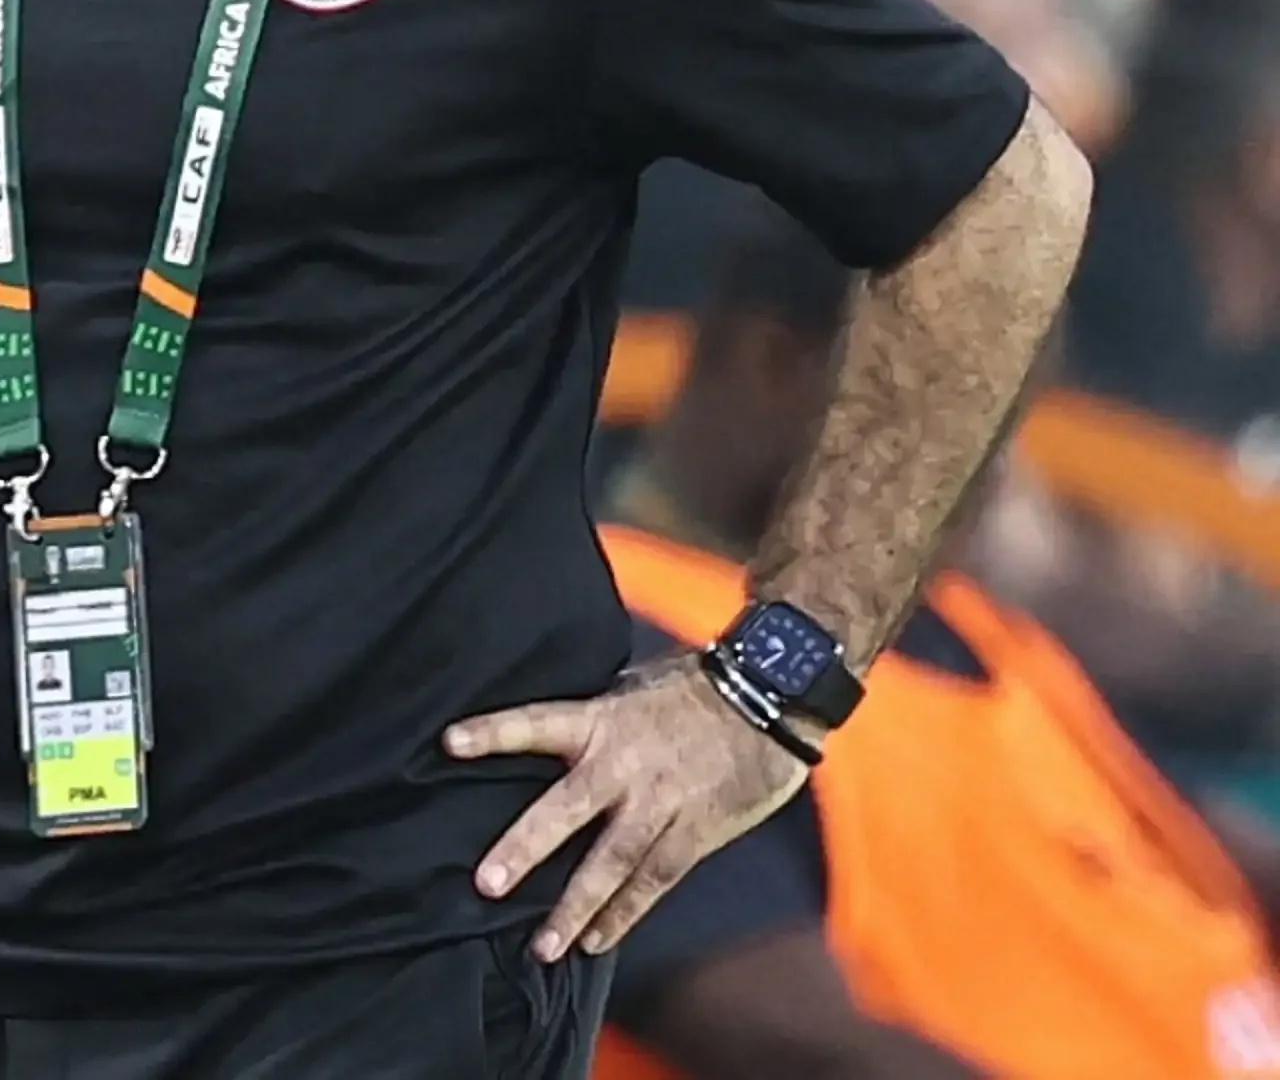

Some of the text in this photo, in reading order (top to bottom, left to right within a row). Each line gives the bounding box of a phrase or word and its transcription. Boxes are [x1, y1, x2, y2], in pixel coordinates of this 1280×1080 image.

[203, 1, 251, 102] AFRICA
[181, 126, 211, 204] CAF
[68, 784, 107, 803] PMA
